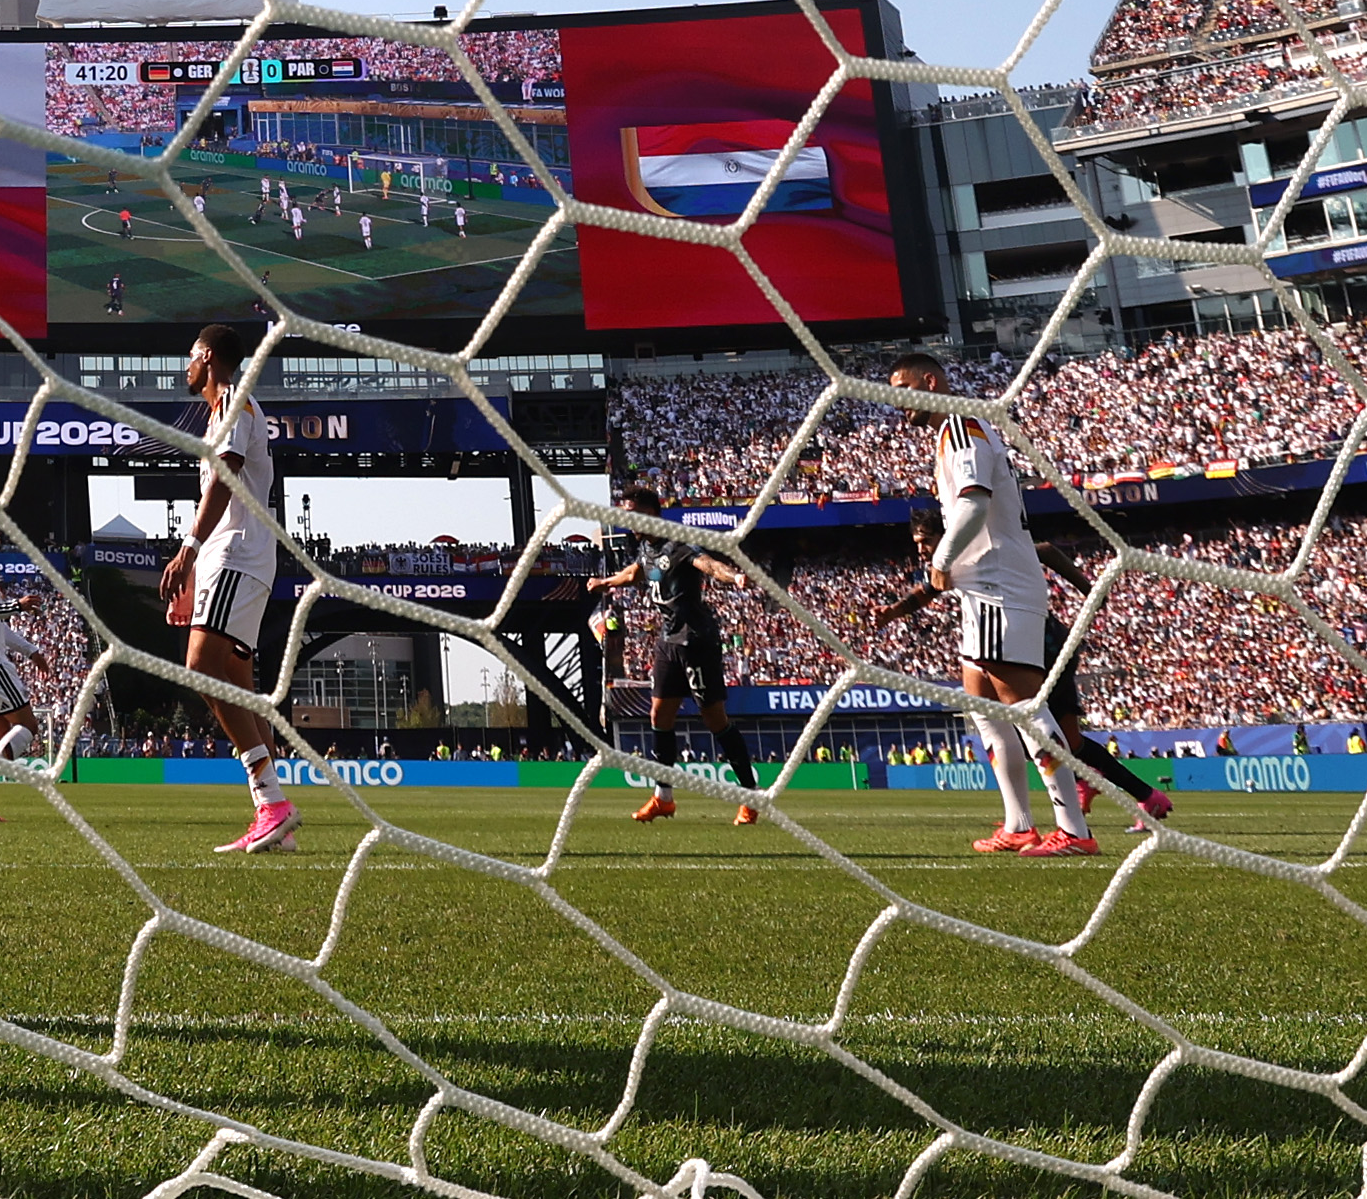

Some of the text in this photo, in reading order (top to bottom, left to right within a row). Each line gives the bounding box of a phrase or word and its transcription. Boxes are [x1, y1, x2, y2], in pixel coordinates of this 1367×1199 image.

[76, 65, 128, 81] 41:20
[188, 64, 213, 78] GER
[267, 64, 277, 78] 0
[288, 62, 315, 77] PAR
[190, 148, 225, 165] aramco
[286, 159, 328, 177] aramco
[400, 174, 453, 194] aramco
[36, 421, 139, 446] 2026
[266, 414, 348, 440] STON
[1085, 482, 1159, 505] OSTON
[95, 549, 156, 567] BOSTON
[412, 553, 449, 564] SOEST
[412, 563, 450, 575] RULES
[383, 584, 412, 598] CUP
[414, 584, 467, 599] 2026
[686, 666, 707, 690] 21
[768, 690, 815, 709] FIFA
[817, 689, 894, 709] ORLD
[275, 759, 404, 786] aramco
[934, 763, 987, 791] aramco
[1224, 755, 1311, 792] aramco
